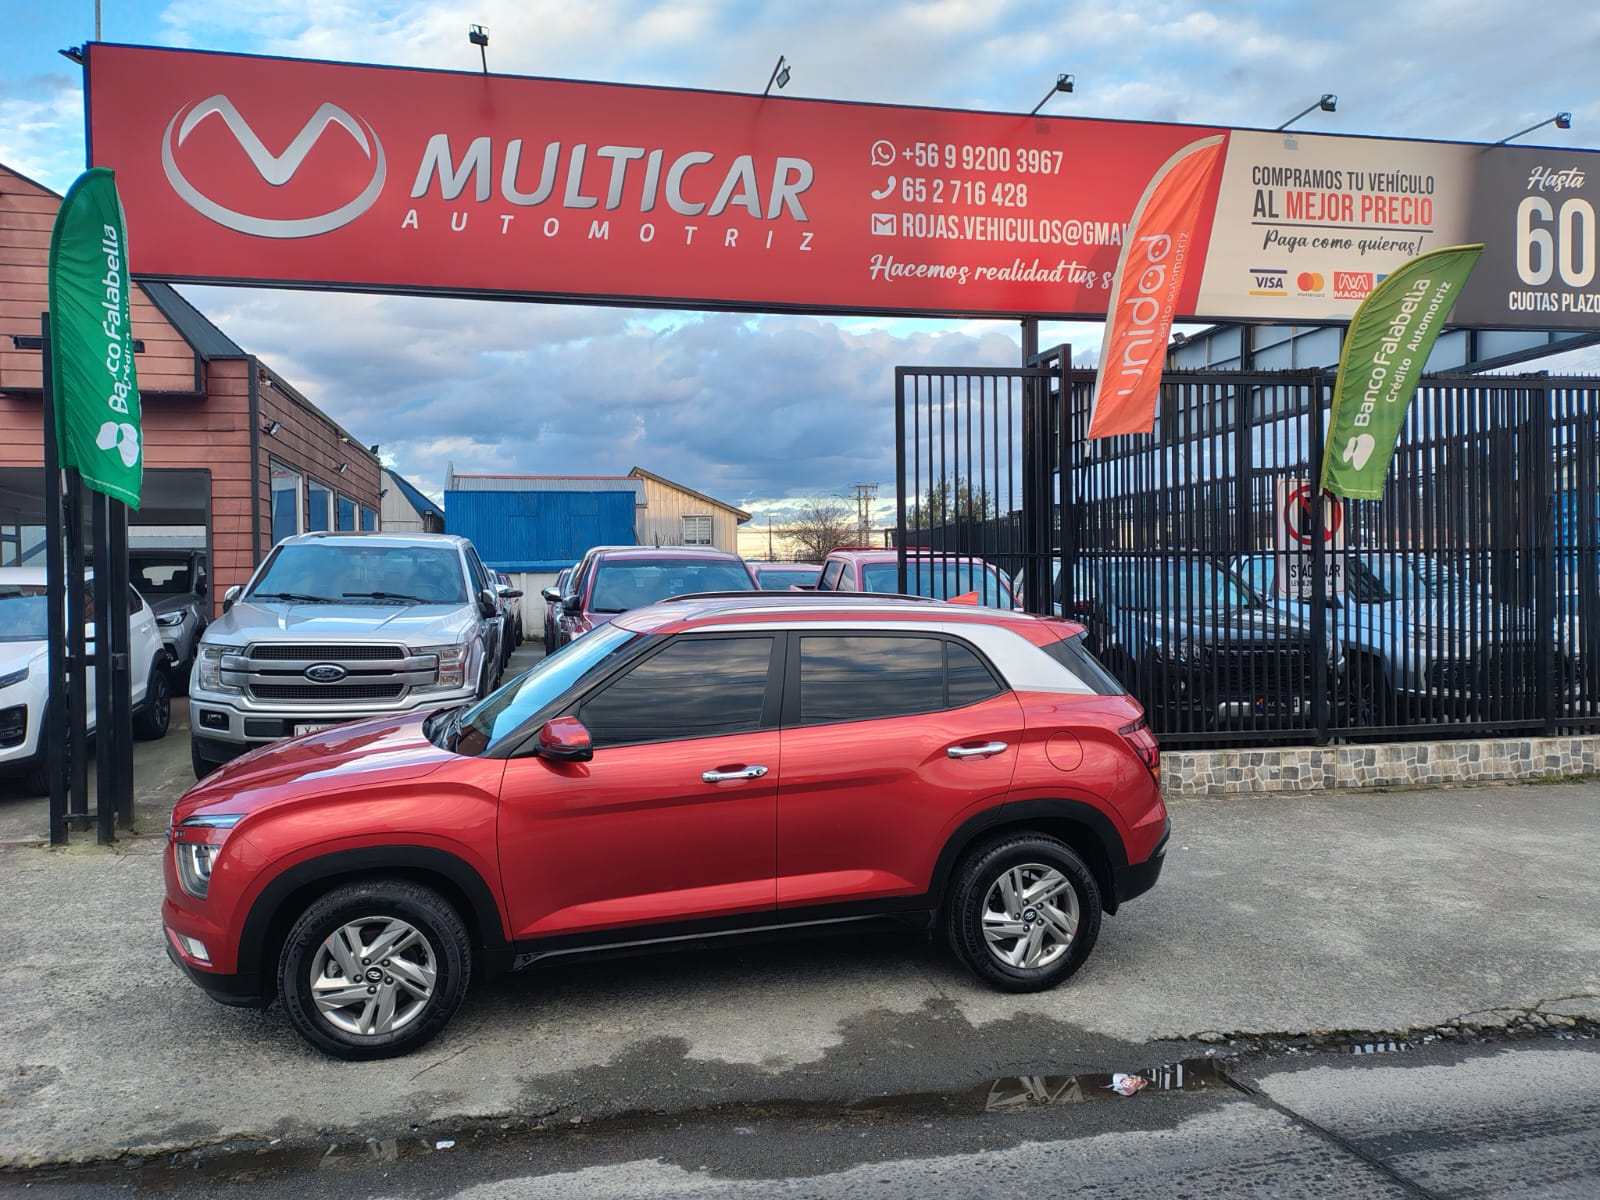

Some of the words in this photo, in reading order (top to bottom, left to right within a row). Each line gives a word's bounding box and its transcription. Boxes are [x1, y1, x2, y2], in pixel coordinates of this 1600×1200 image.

[902, 142, 939, 168] +56
[944, 144, 956, 169] 9
[962, 145, 1011, 172] 9200
[1015, 148, 1064, 175] 3967
[409, 133, 815, 222] MULTICAR
[902, 176, 927, 203] 65
[932, 178, 944, 204] 2
[950, 179, 986, 206] 716
[991, 182, 1028, 208] 428
[1252, 165, 1343, 190] COMPRAMOS
[1347, 171, 1364, 191] TU
[1368, 170, 1435, 195] VEHÍCULO
[1527, 165, 1586, 193] Hasta
[1253, 189, 1279, 218] AL
[1286, 190, 1354, 222] MEJOR
[1360, 194, 1433, 226] PRECIO
[402, 208, 815, 252] AUTOMOTRIZ
[902, 212, 1131, 247] ROJAS.VEHICULOS@GMAI
[1263, 229, 1309, 253] Paga
[1312, 238, 1354, 251] como
[1358, 235, 1424, 257] quieras!
[1516, 195, 1596, 288] 60
[869, 254, 972, 285] Hacemos
[974, 257, 1063, 284] realidad
[1057, 259, 1098, 290] tus
[1166, 231, 1190, 304] automotriz
[1254, 276, 1284, 289] VISA
[1117, 233, 1172, 396] unidad
[1508, 291, 1559, 312] CUOTAS
[1385, 357, 1412, 404] Crédito
[1406, 281, 1452, 352] Automotriz
